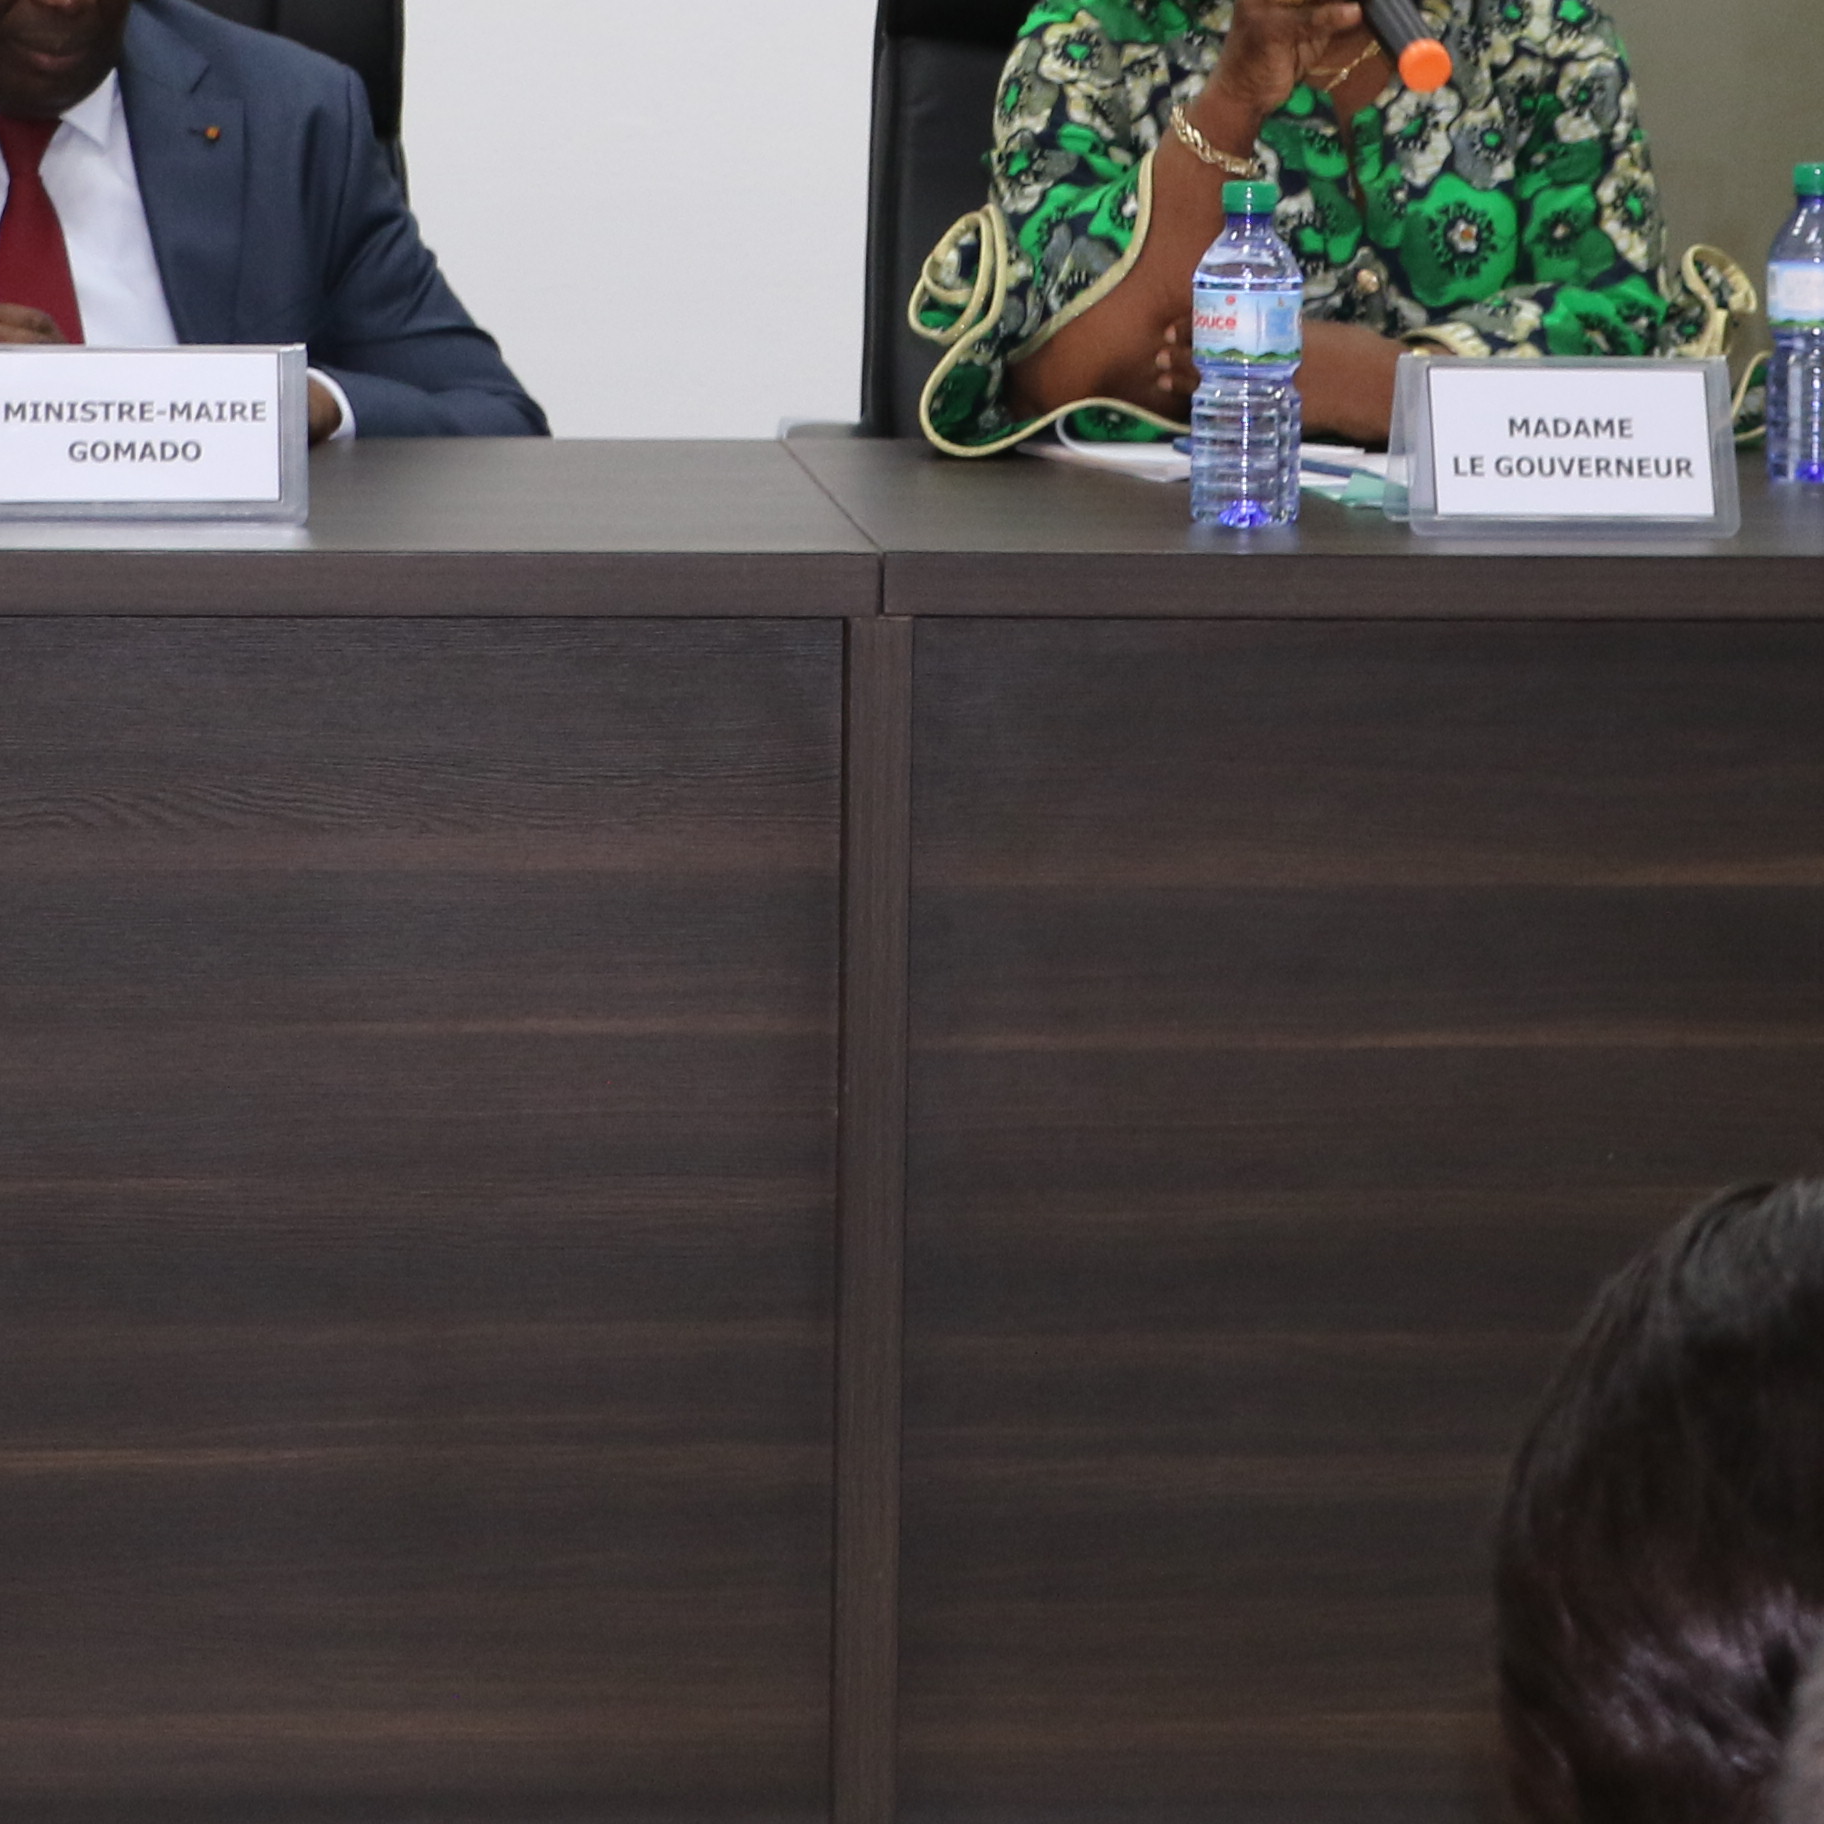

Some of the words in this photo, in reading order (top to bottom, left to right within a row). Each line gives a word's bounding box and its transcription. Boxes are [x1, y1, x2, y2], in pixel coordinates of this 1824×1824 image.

[3, 400, 268, 424] MINISTRE-MAIRE
[1508, 417, 1634, 440] MADAME
[67, 440, 203, 463] GOMADO
[1452, 456, 1487, 478] LE
[1494, 456, 1694, 479] GOUVERNEUR
